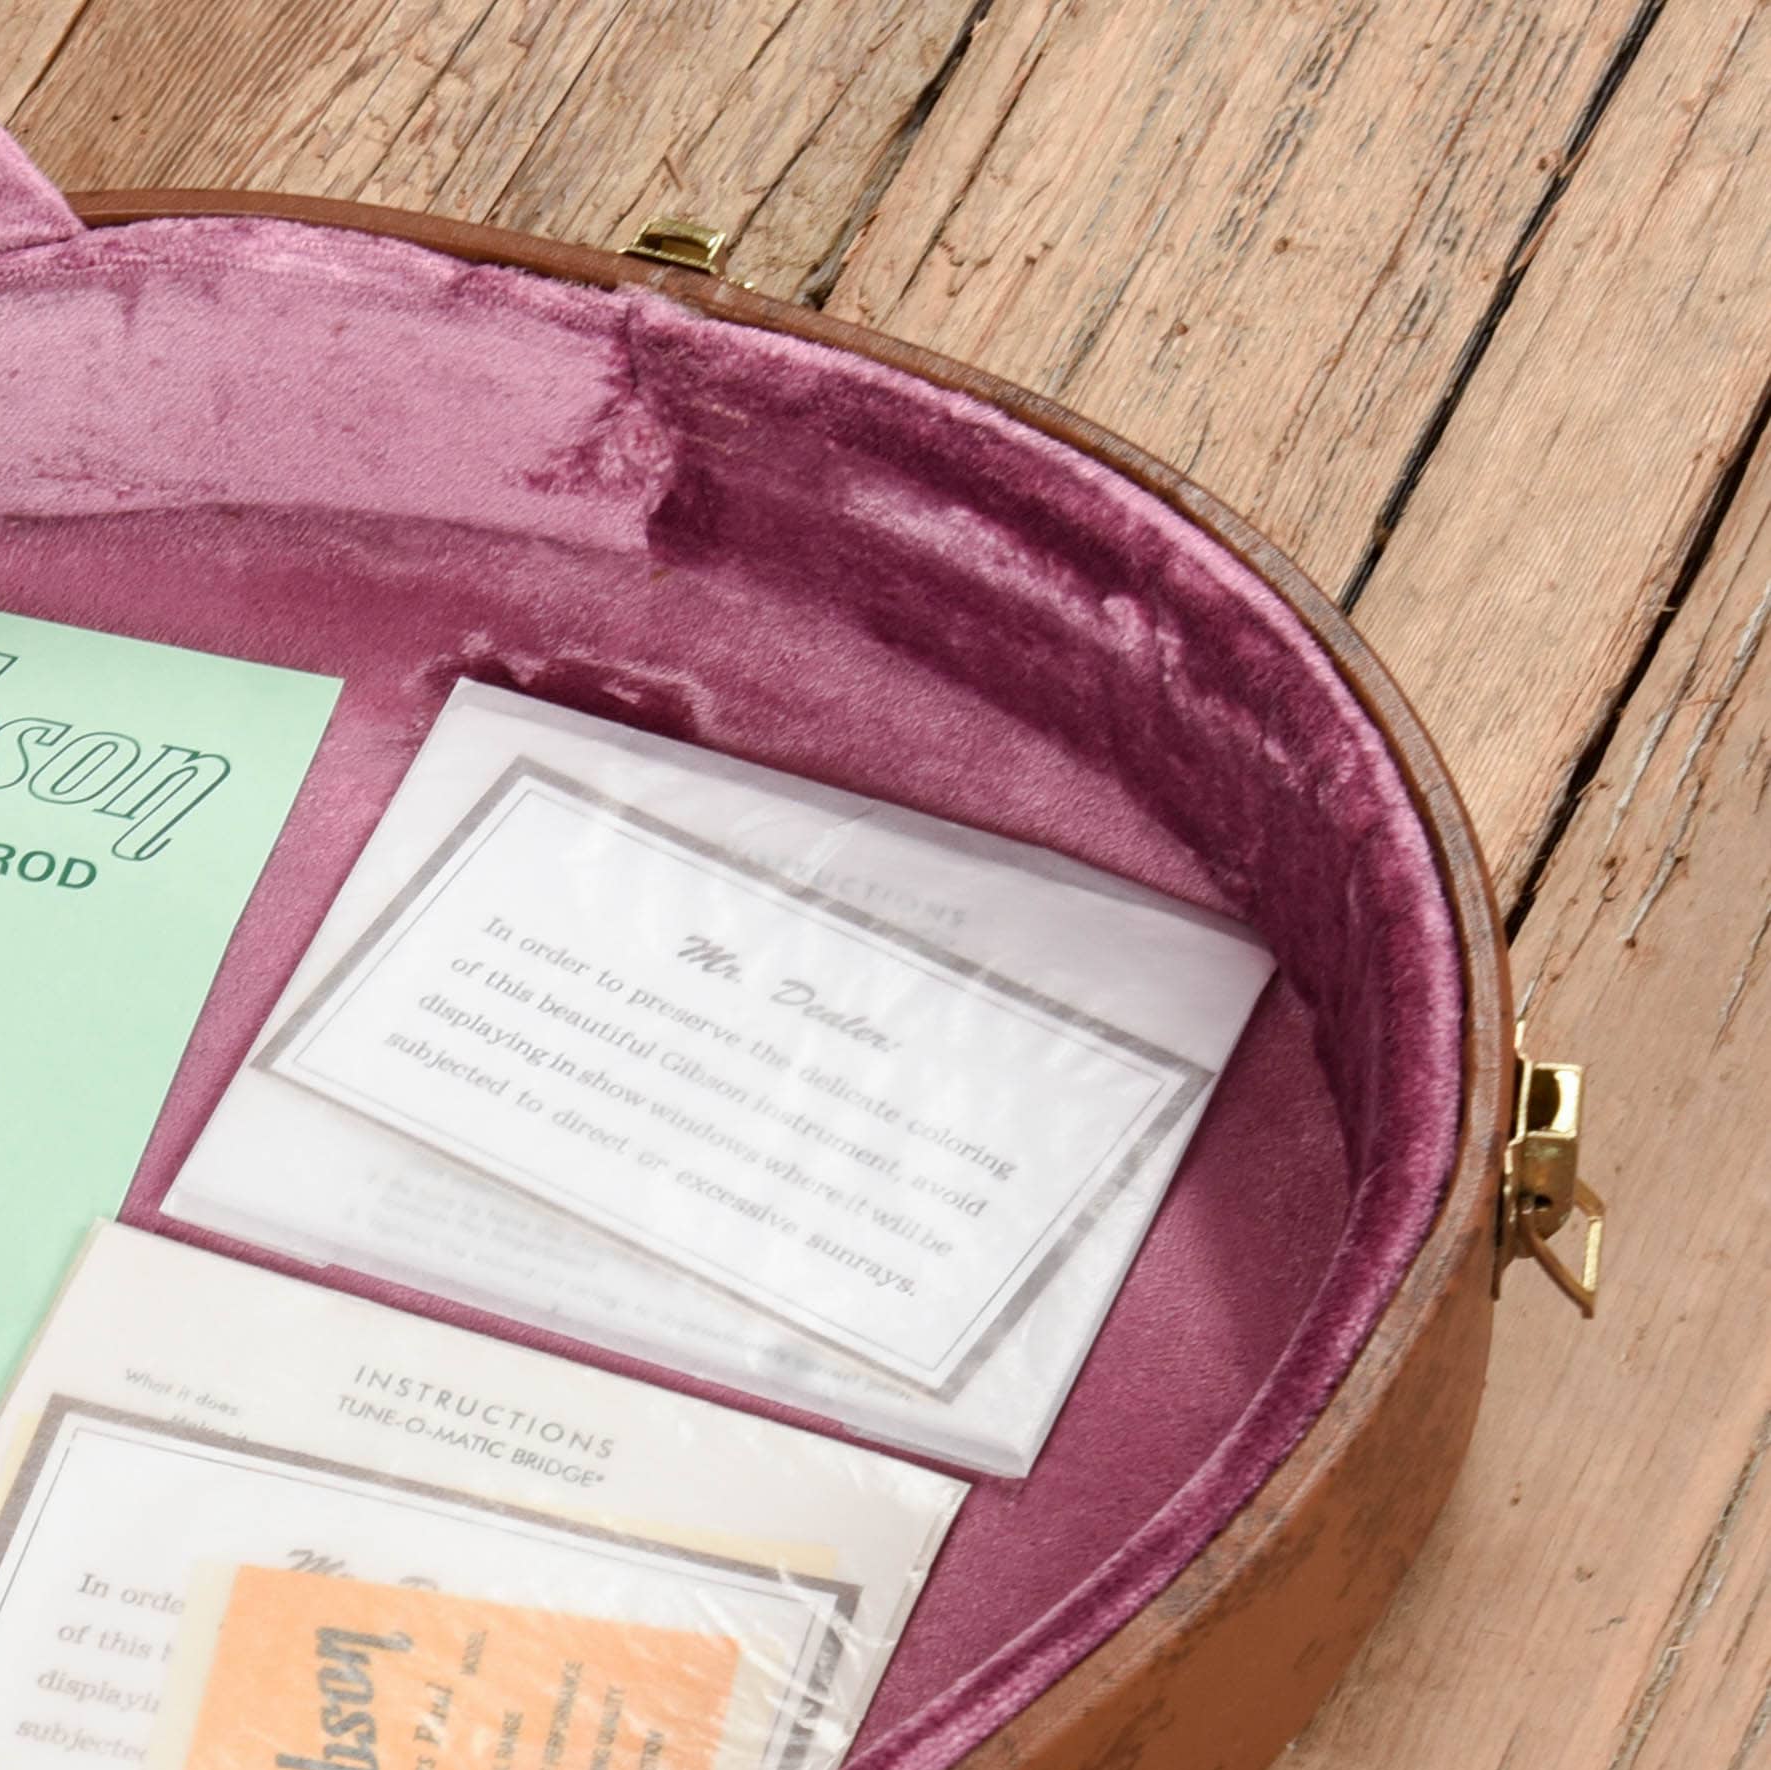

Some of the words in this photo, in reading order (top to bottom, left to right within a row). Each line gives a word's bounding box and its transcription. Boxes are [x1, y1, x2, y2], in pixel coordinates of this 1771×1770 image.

[677, 933, 742, 984] Mr.
[449, 954, 479, 977] of
[484, 965, 534, 1004] this
[535, 990, 659, 1059] beautiful
[660, 1051, 750, 1106] Gibson
[752, 1093, 904, 1184] instrument,
[910, 1173, 988, 1219] avoid
[480, 915, 511, 939] In
[518, 933, 592, 978] order
[595, 968, 626, 994] to
[628, 986, 742, 1049] preserve
[750, 1038, 792, 1071] the
[797, 1059, 901, 1124] delicate
[906, 1113, 1018, 1182] coloring
[383, 1030, 510, 1099] subjected
[515, 1085, 544, 1113] to
[550, 1103, 630, 1157] direct
[637, 1146, 671, 1172] or
[674, 1166, 800, 1238] excessive
[805, 1231, 916, 1297] sunrays.
[418, 992, 549, 1070] displaying
[554, 1052, 578, 1077] in
[578, 1064, 647, 1108] show
[649, 1096, 764, 1168] windows
[764, 1151, 842, 1203] where
[844, 1193, 870, 1216] it
[871, 1207, 922, 1241] will
[918, 1227, 954, 1258] be
[337, 1394, 506, 1460] TUNE-O-MATIC
[354, 1364, 615, 1460] INSTRUCTIONS
[57, 1623, 91, 1645] of
[98, 1629, 153, 1661] this
[77, 1573, 109, 1598] In
[121, 1586, 186, 1616] orde
